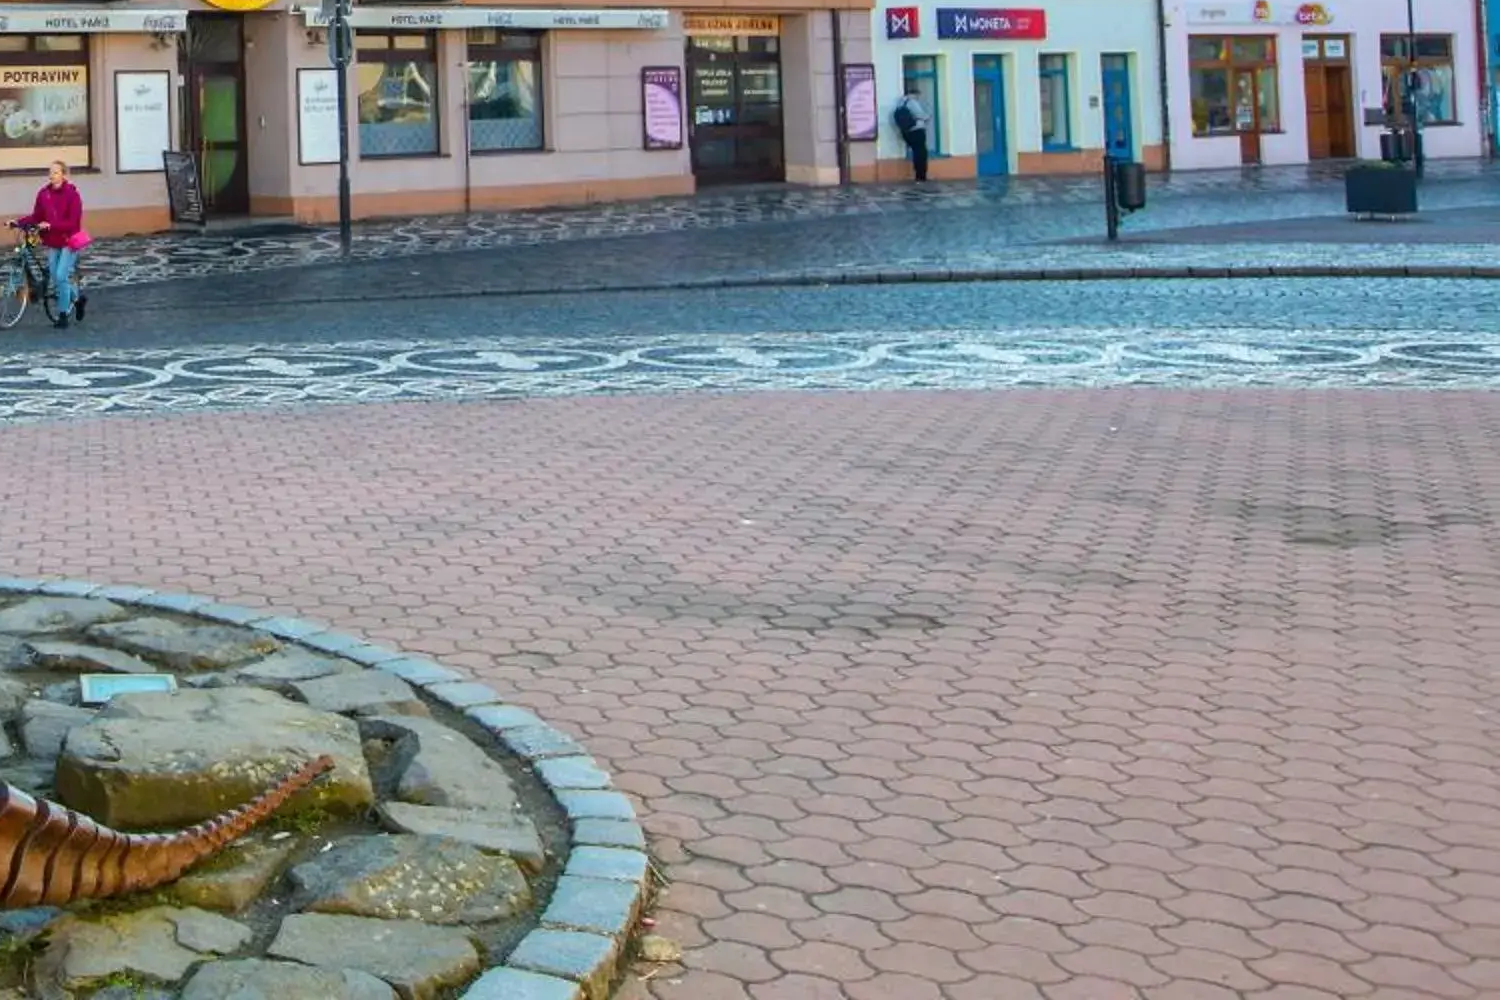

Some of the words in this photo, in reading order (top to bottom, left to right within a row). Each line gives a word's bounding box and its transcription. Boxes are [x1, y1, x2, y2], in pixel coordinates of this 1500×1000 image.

[45, 17, 78, 29] HOTEL
[391, 15, 417, 25] HOTEL
[969, 17, 1011, 30] MONETA
[3, 71, 80, 83] POTRAVINY
